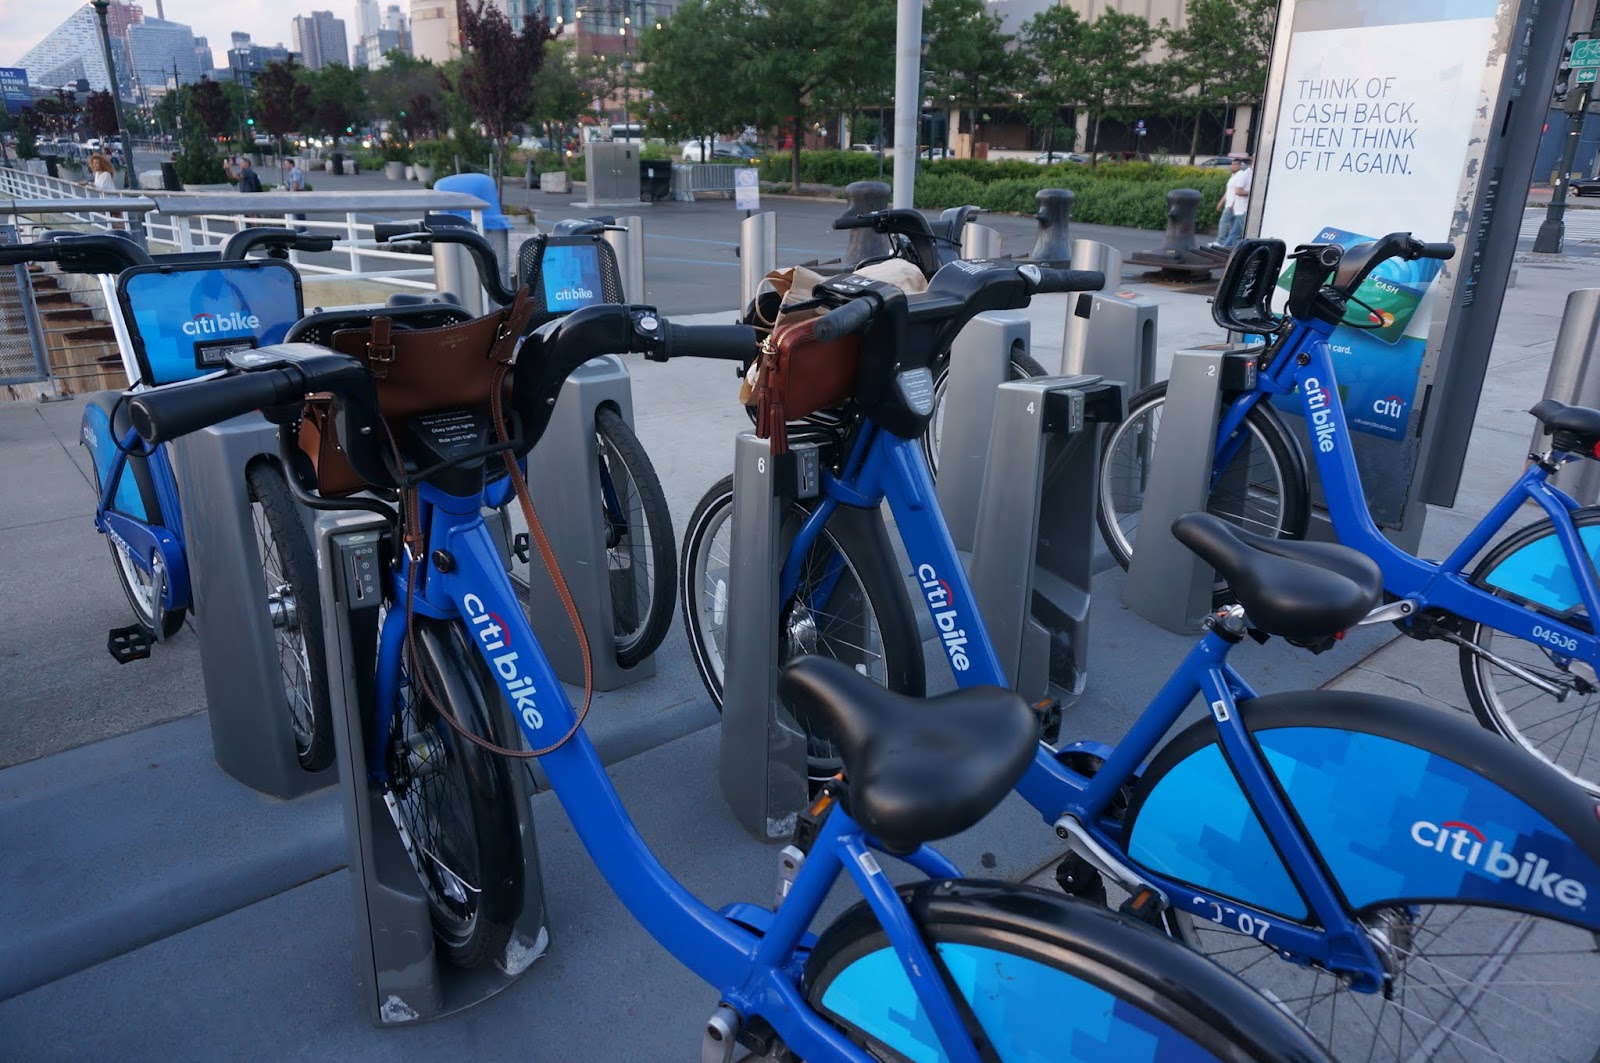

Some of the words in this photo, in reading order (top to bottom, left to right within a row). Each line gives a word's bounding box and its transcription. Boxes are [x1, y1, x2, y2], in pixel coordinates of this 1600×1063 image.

[1298, 78, 1359, 99] THINK
[1366, 77, 1396, 98] OF
[1293, 103, 1348, 123] CASH
[1354, 102, 1418, 123] BACK.
[1290, 128, 1343, 147] THEN
[1351, 128, 1417, 149] THINK
[1285, 151, 1312, 170] OF
[1316, 151, 1335, 171] IT
[1339, 152, 1411, 175] AGAIN.
[1321, 231, 1337, 241] citi
[554, 288, 572, 300] citi
[571, 288, 593, 299] bike
[1375, 281, 1399, 295] CASH
[1095, 302, 1101, 311] 1
[182, 314, 216, 335] citi
[215, 312, 260, 332] bike
[1332, 344, 1352, 354] card.
[1208, 364, 1216, 377] 2
[1304, 377, 1330, 410] citi
[1026, 401, 1035, 415] 4
[1373, 396, 1403, 419] citi
[1311, 408, 1336, 453] bike
[757, 456, 766, 474] 6
[918, 563, 954, 609] citi
[935, 609, 970, 672] bike
[463, 593, 511, 651] citi
[493, 651, 544, 730] bike
[1410, 820, 1487, 867] citi
[1483, 840, 1588, 908] bike
